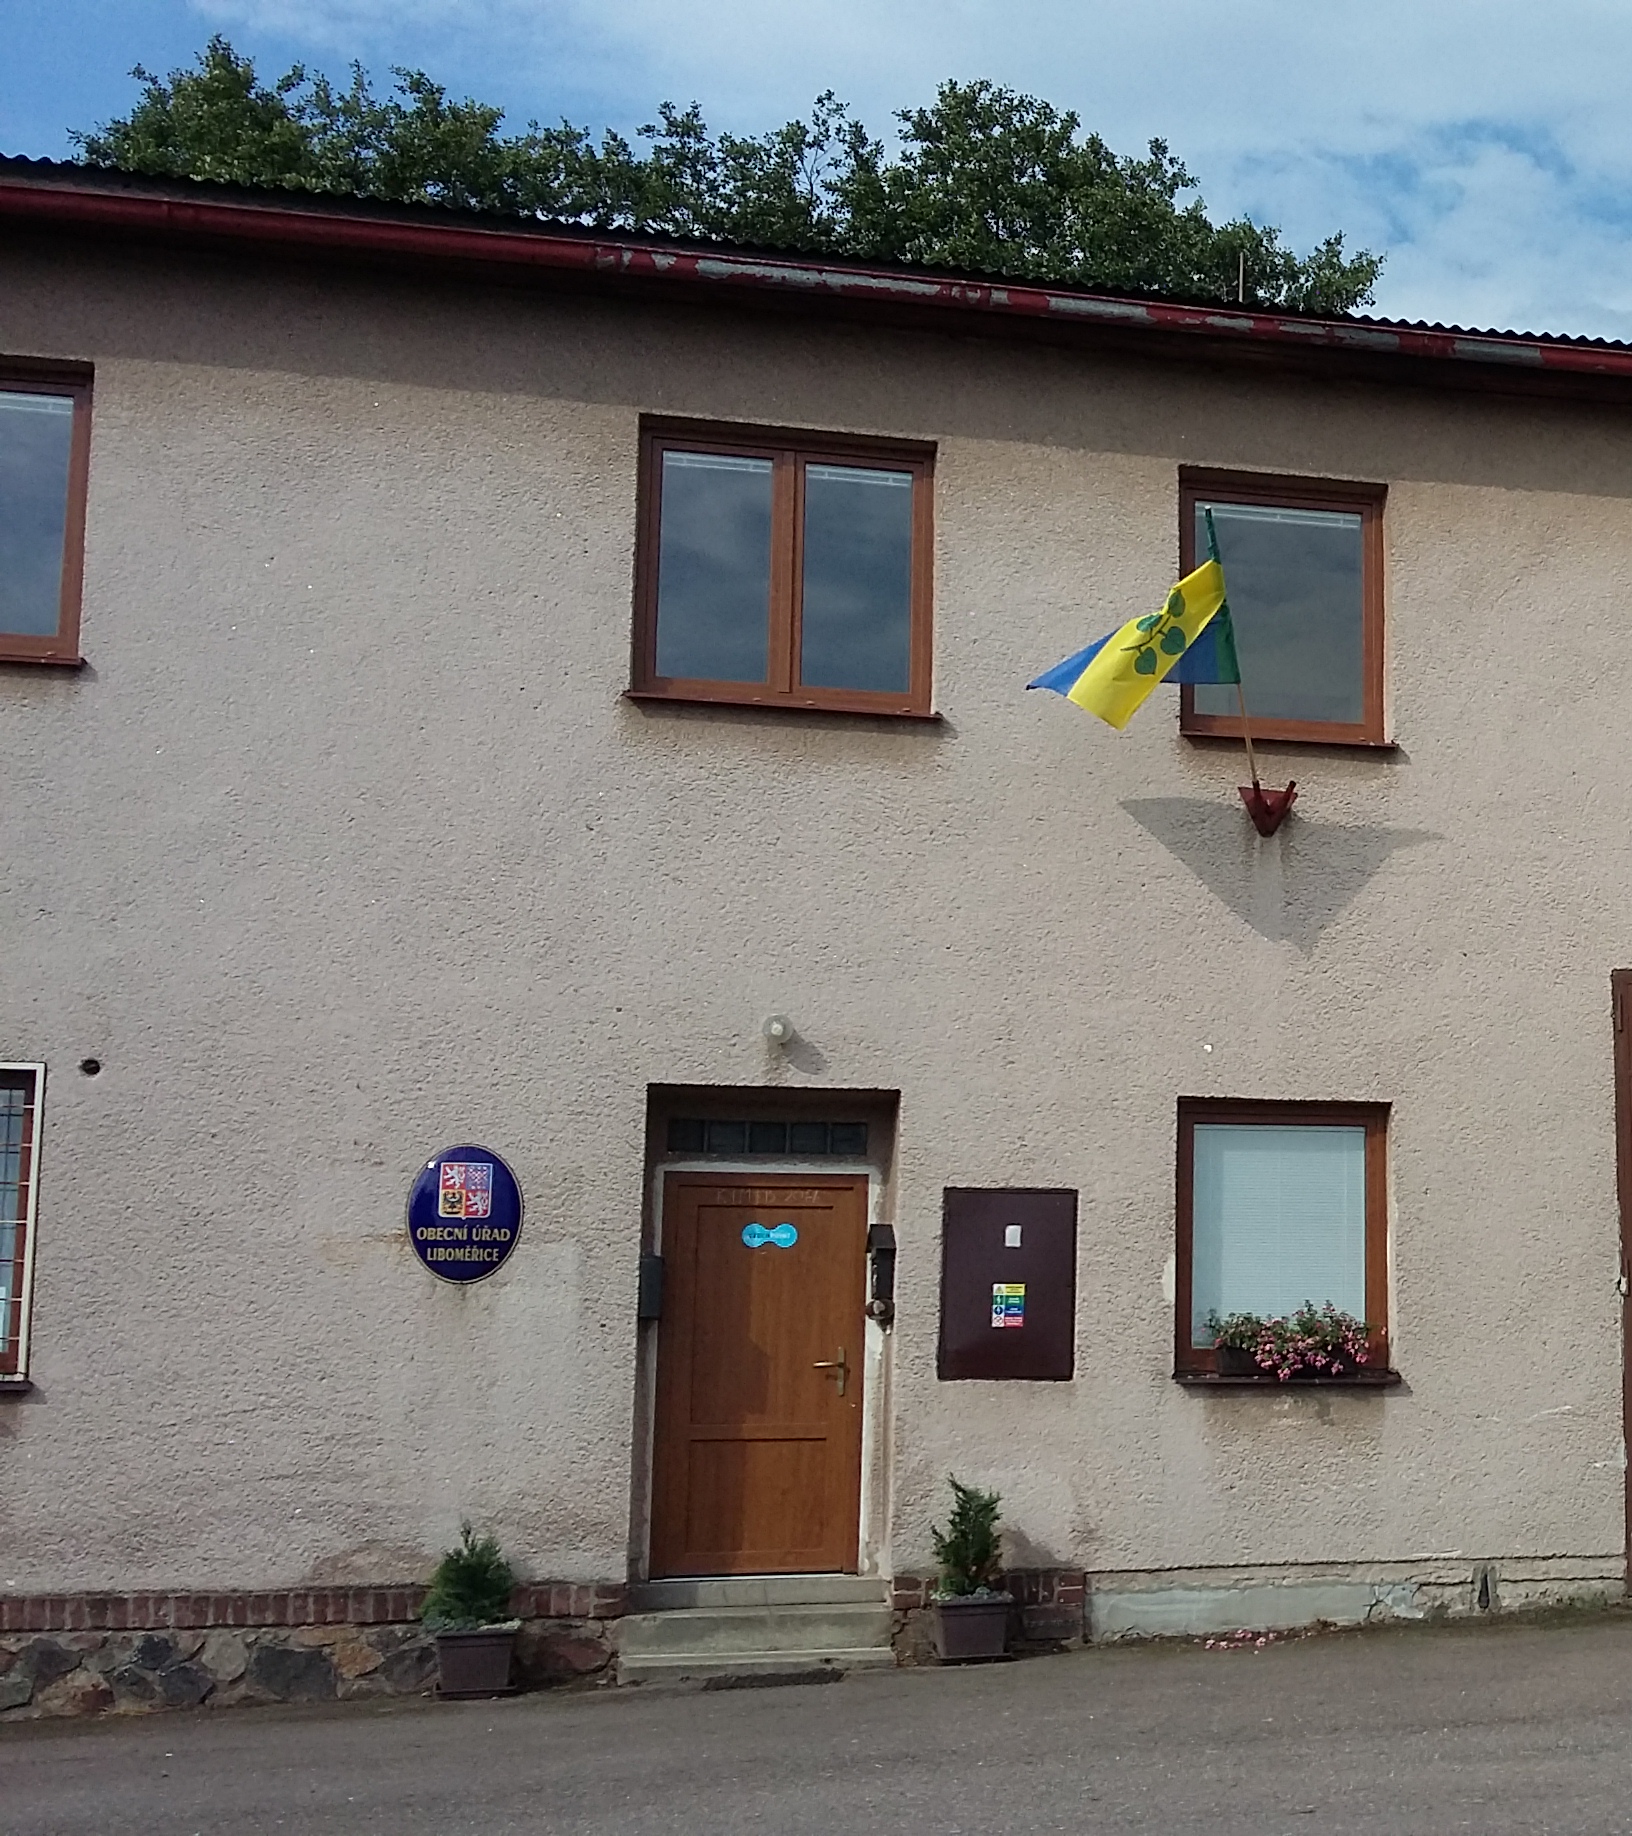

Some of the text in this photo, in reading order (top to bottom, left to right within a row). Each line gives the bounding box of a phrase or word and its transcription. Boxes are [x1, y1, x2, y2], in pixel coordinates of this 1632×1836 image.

[416, 1224, 511, 1241] OBECNÍ ÚŘAD
[427, 1244, 500, 1262] LIBOMĚŘICE
